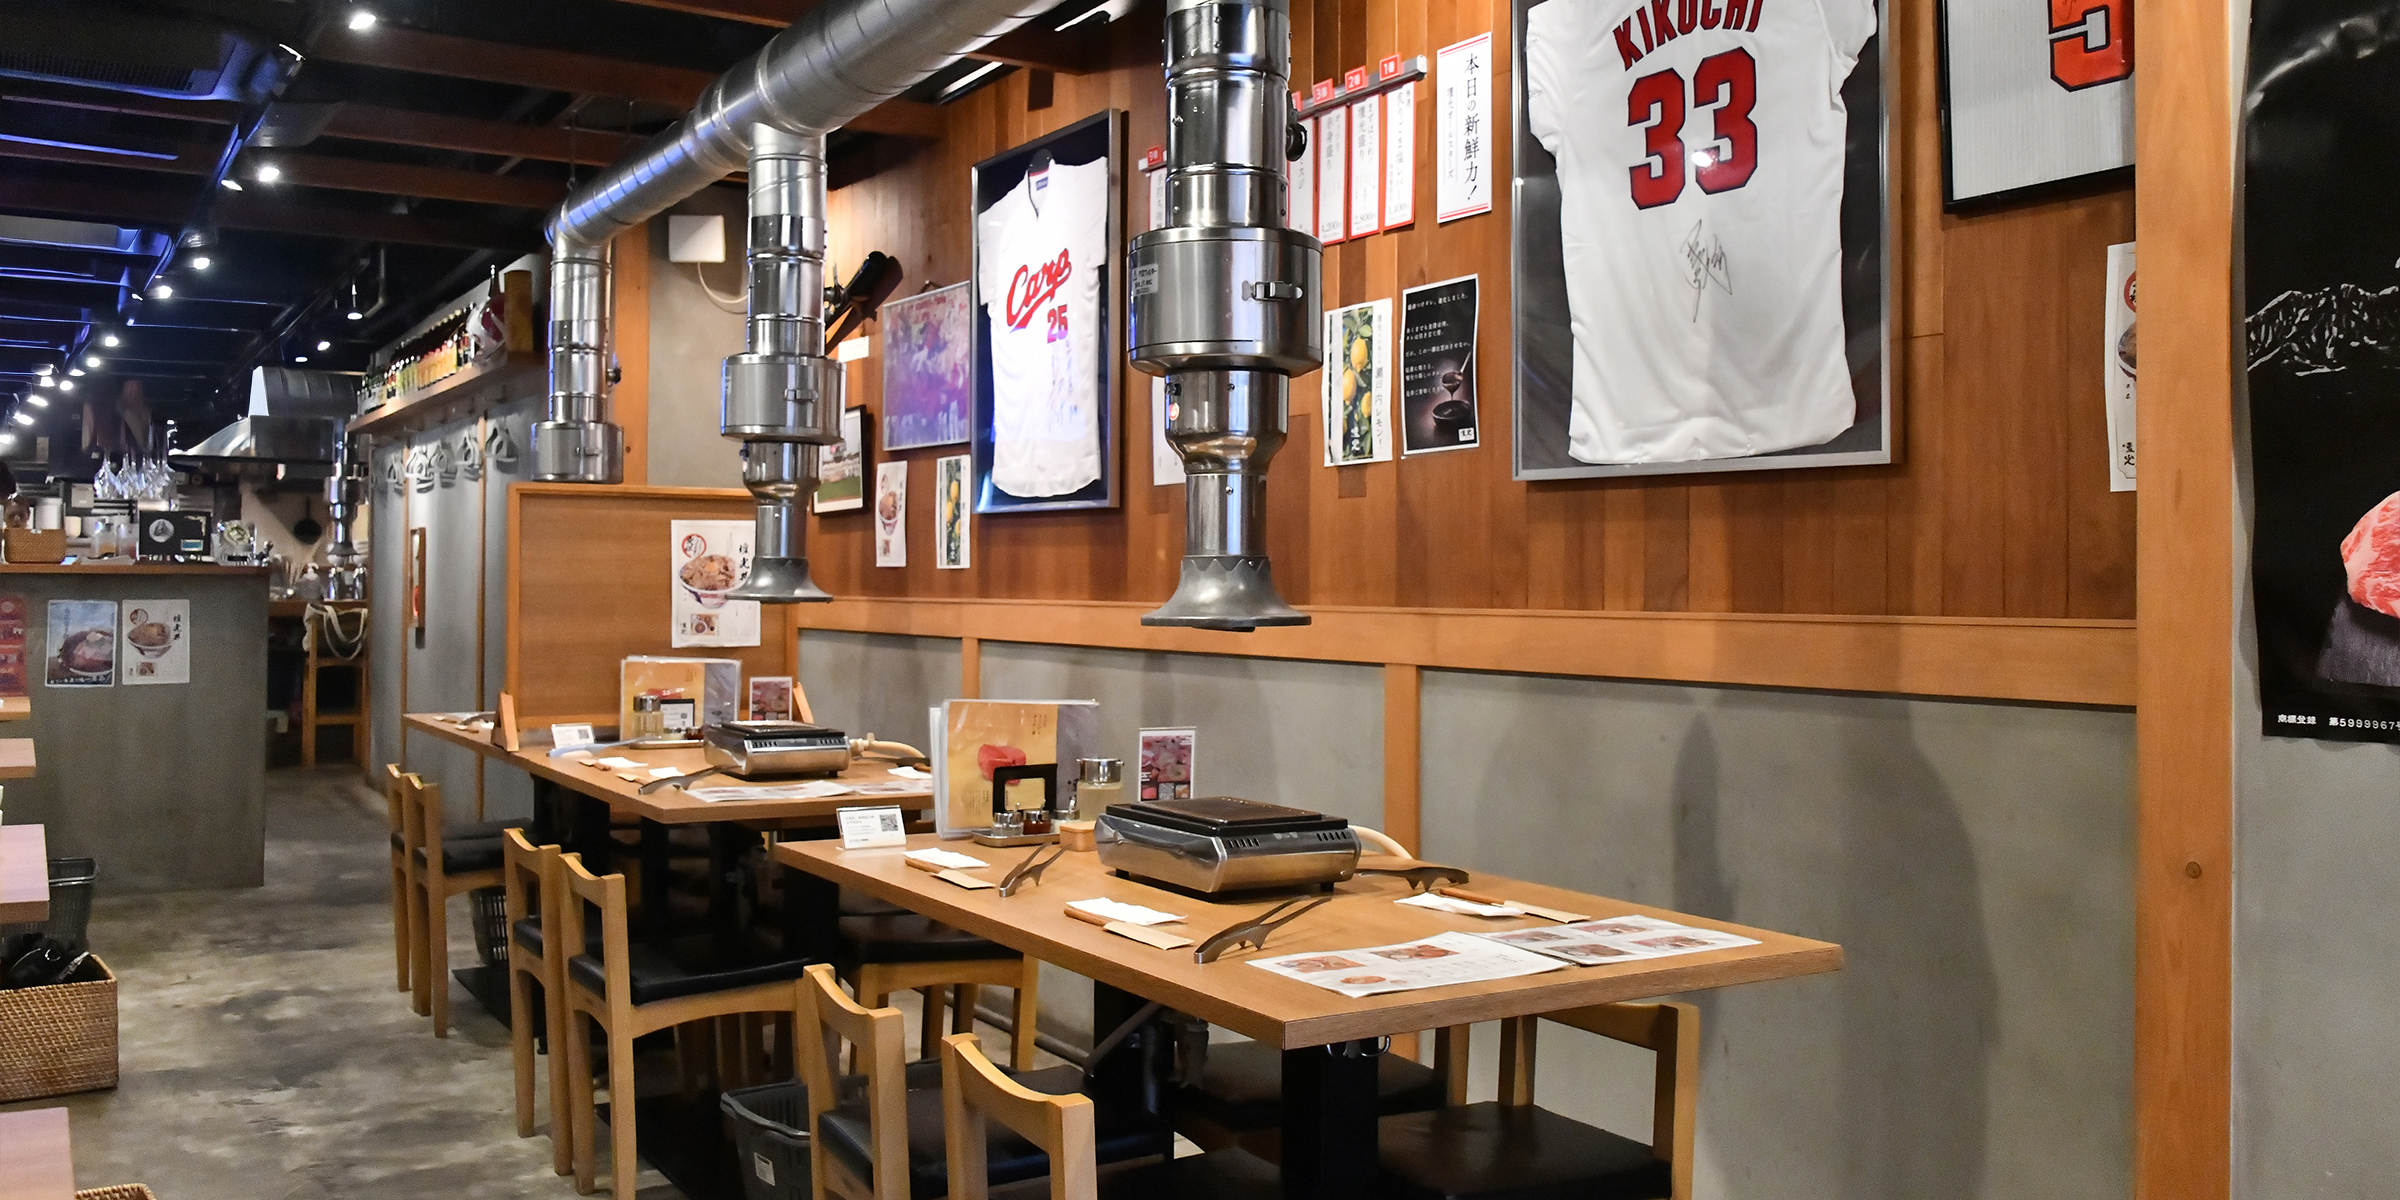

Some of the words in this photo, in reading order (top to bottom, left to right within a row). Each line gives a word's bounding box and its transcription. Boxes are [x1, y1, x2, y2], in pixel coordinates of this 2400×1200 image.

[1613, 0, 1763, 71] KIKUCHI
[1627, 46, 1758, 210] 33
[1007, 248, 1072, 333] Carp
[1046, 304, 1068, 344] 25
